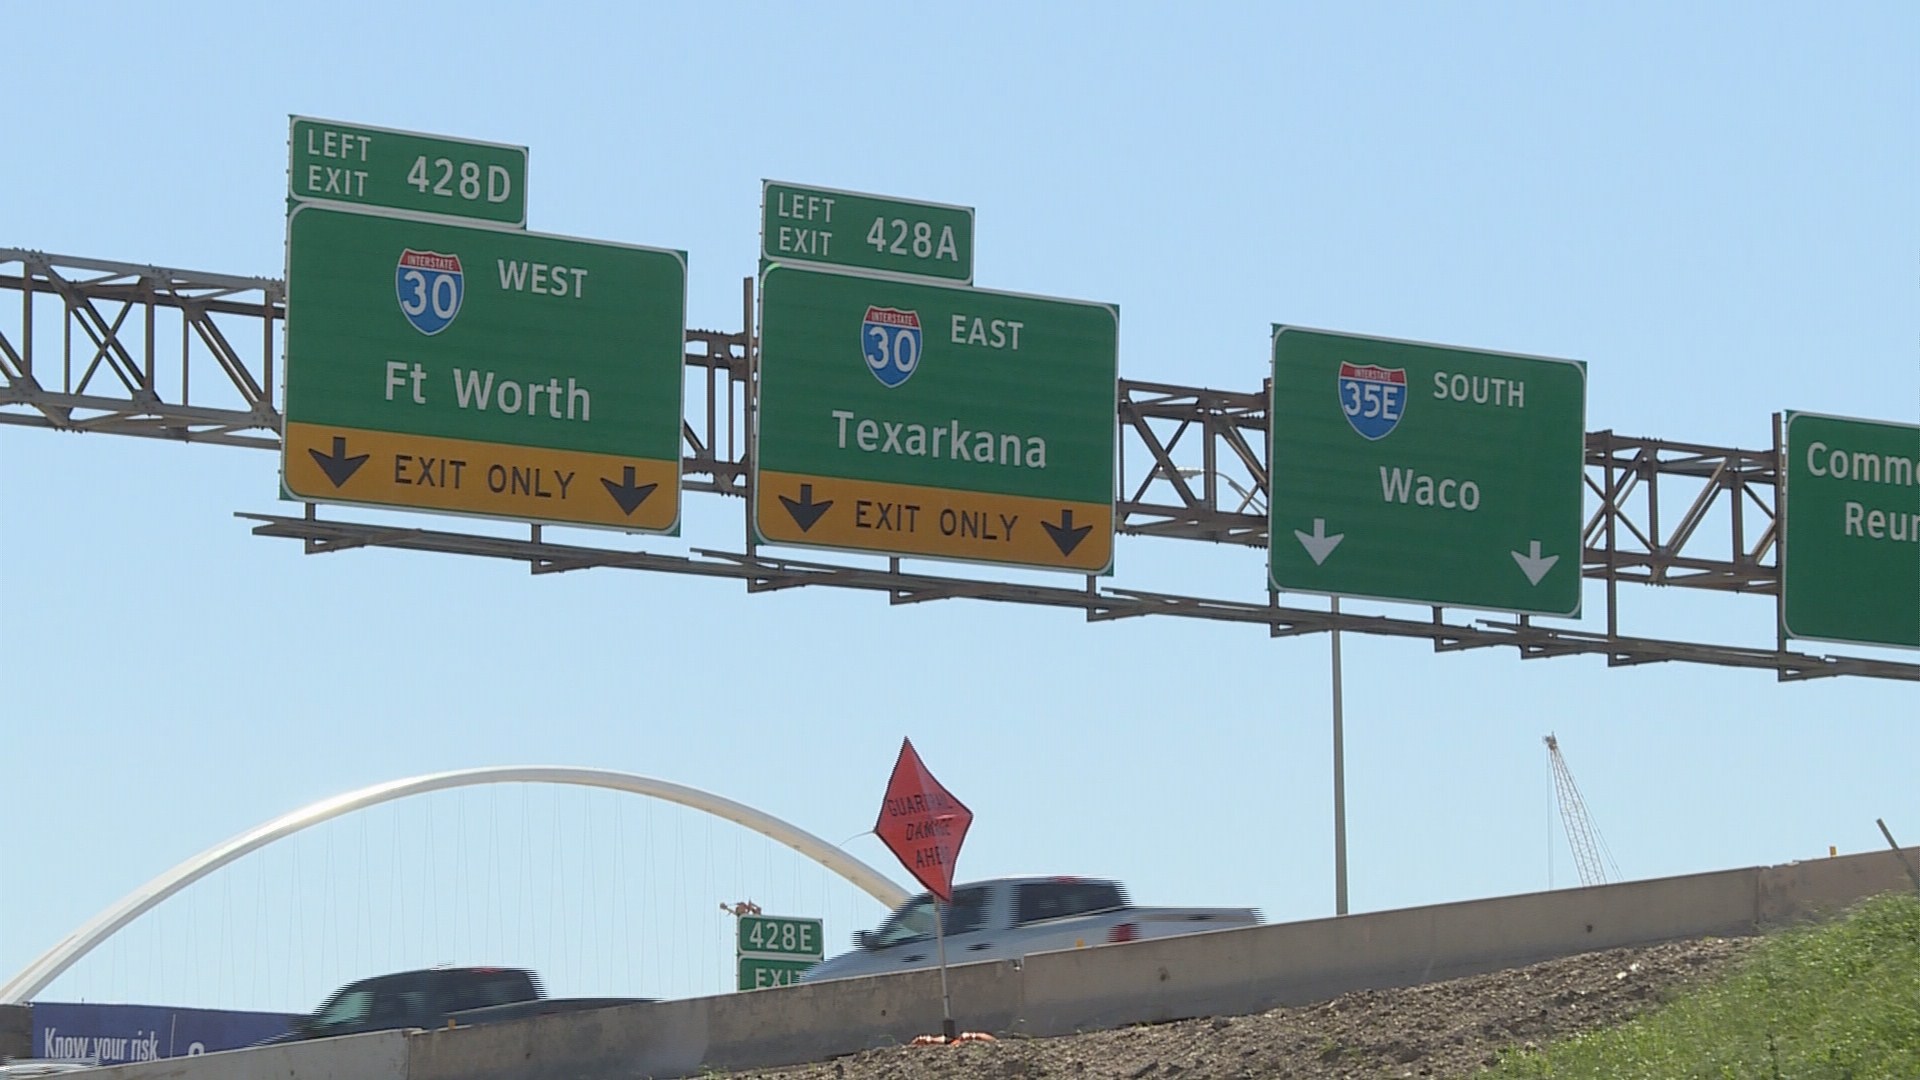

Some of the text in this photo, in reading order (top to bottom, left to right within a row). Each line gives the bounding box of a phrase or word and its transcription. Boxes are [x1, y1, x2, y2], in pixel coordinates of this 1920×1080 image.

[307, 129, 372, 162] LEFT
[307, 165, 368, 197] EXIT
[407, 155, 511, 203] 428D
[778, 192, 835, 223] LEFT
[778, 226, 832, 256] EXIT
[866, 216, 959, 262] 428A
[407, 254, 454, 271] INTERSTATE
[497, 259, 588, 299] WEST
[402, 271, 458, 320] 30
[870, 311, 914, 327] INTERSTATE
[951, 314, 1024, 350] EAST
[867, 327, 917, 372] 30
[385, 361, 590, 421] Ft Worth
[1353, 369, 1391, 382] INTERSTATE
[1433, 371, 1525, 408] SOUTH
[1344, 381, 1399, 421] 35E
[832, 409, 1047, 469] Texarkana
[394, 454, 575, 500] EXIT ONLY
[1379, 465, 1480, 511] Waco
[855, 500, 1019, 542] EXIT ONLY
[749, 921, 813, 952] 428E
[44, 1027, 88, 1059] Know
[93, 1037, 127, 1067] your
